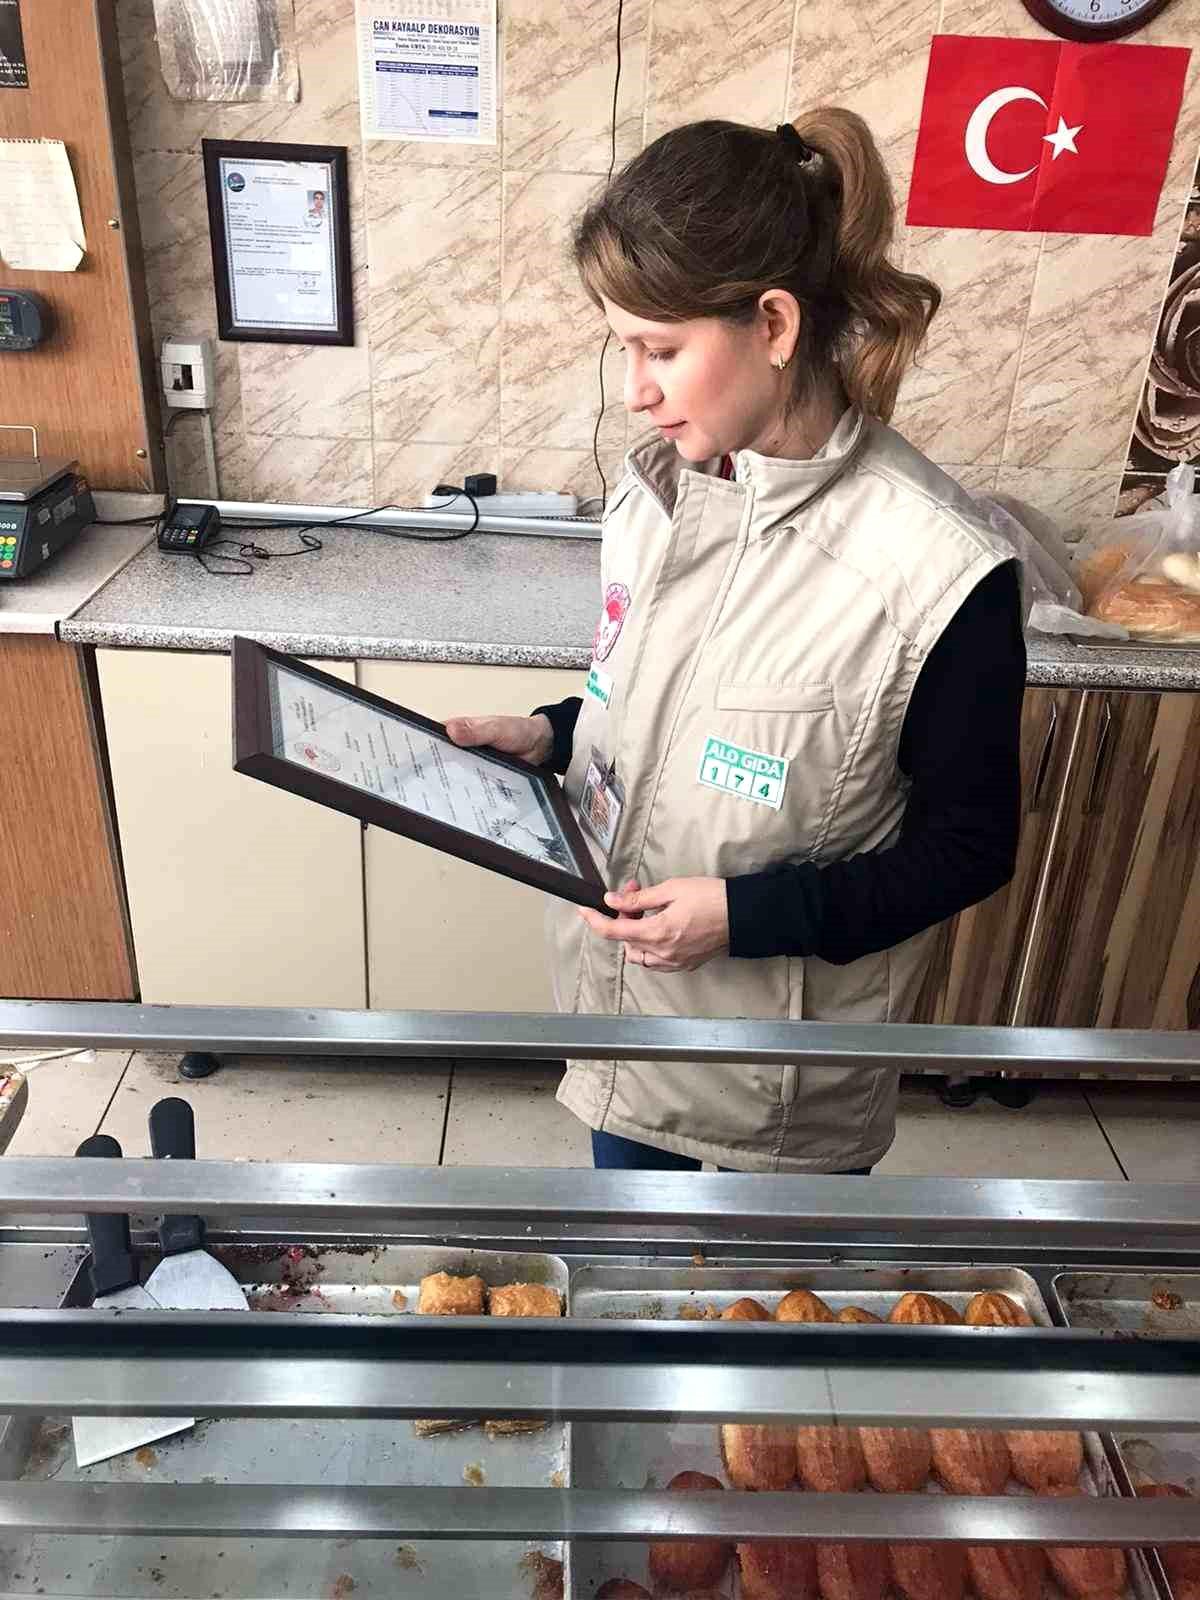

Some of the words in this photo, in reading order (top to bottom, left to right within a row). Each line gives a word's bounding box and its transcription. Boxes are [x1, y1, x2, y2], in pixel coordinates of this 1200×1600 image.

[1090, 0, 1100, 12] 6
[373, 20, 390, 31] CAN
[391, 21, 426, 34] KAYAALP
[428, 23, 480, 36] DEKORASYON
[708, 742, 740, 764] ALO
[742, 755, 781, 779] GIDA
[711, 767, 719, 781] 1
[735, 774, 745, 788] 7
[759, 783, 770, 798] 4
